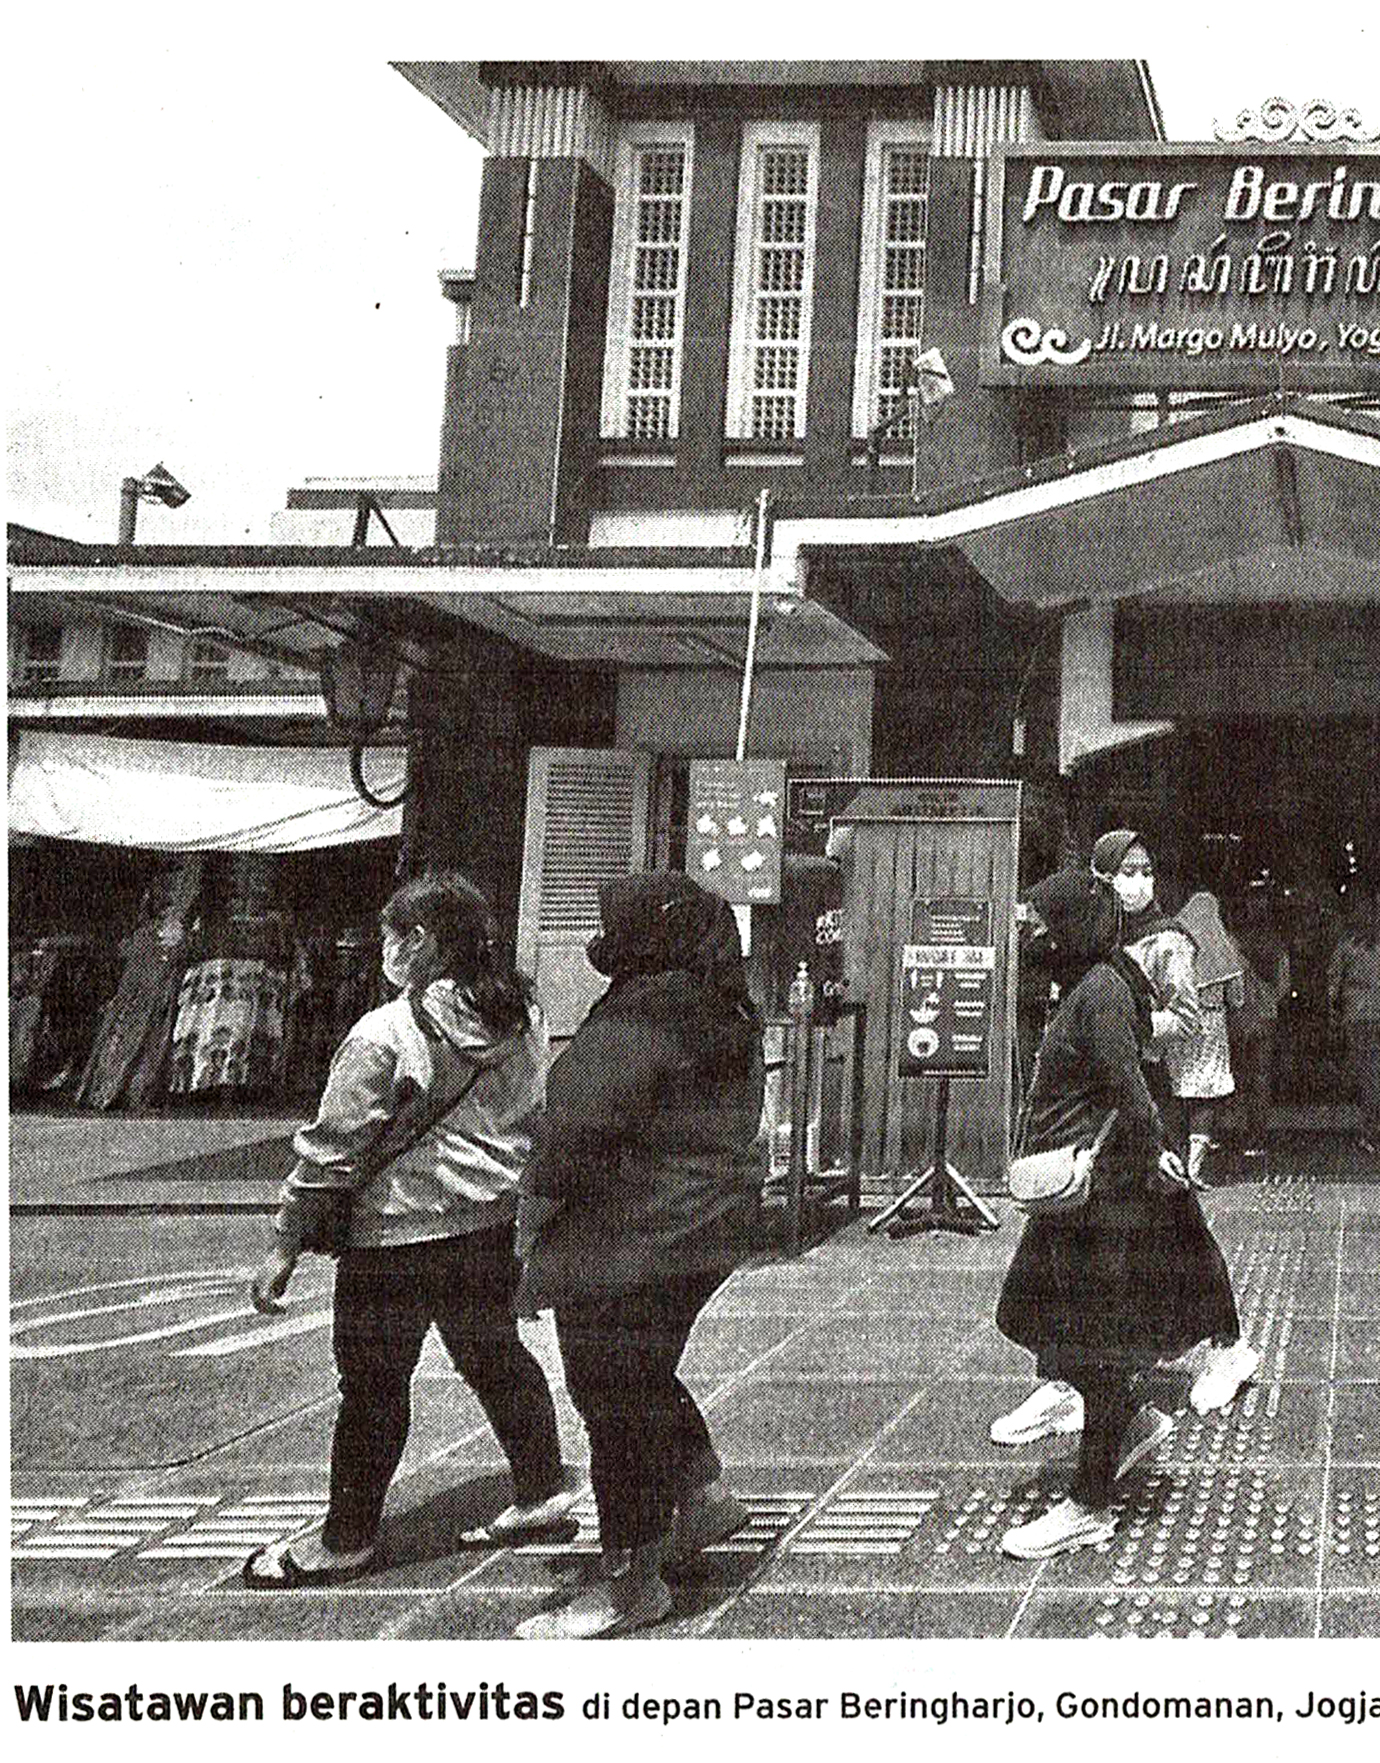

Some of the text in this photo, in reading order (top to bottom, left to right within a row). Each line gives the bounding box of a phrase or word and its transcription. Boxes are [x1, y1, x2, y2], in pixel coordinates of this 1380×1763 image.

[1022, 165, 1197, 222] Pasar
[1097, 323, 1125, 349] Jl.
[1131, 322, 1224, 355] Margo
[1230, 322, 1328, 354] Mulyo,
